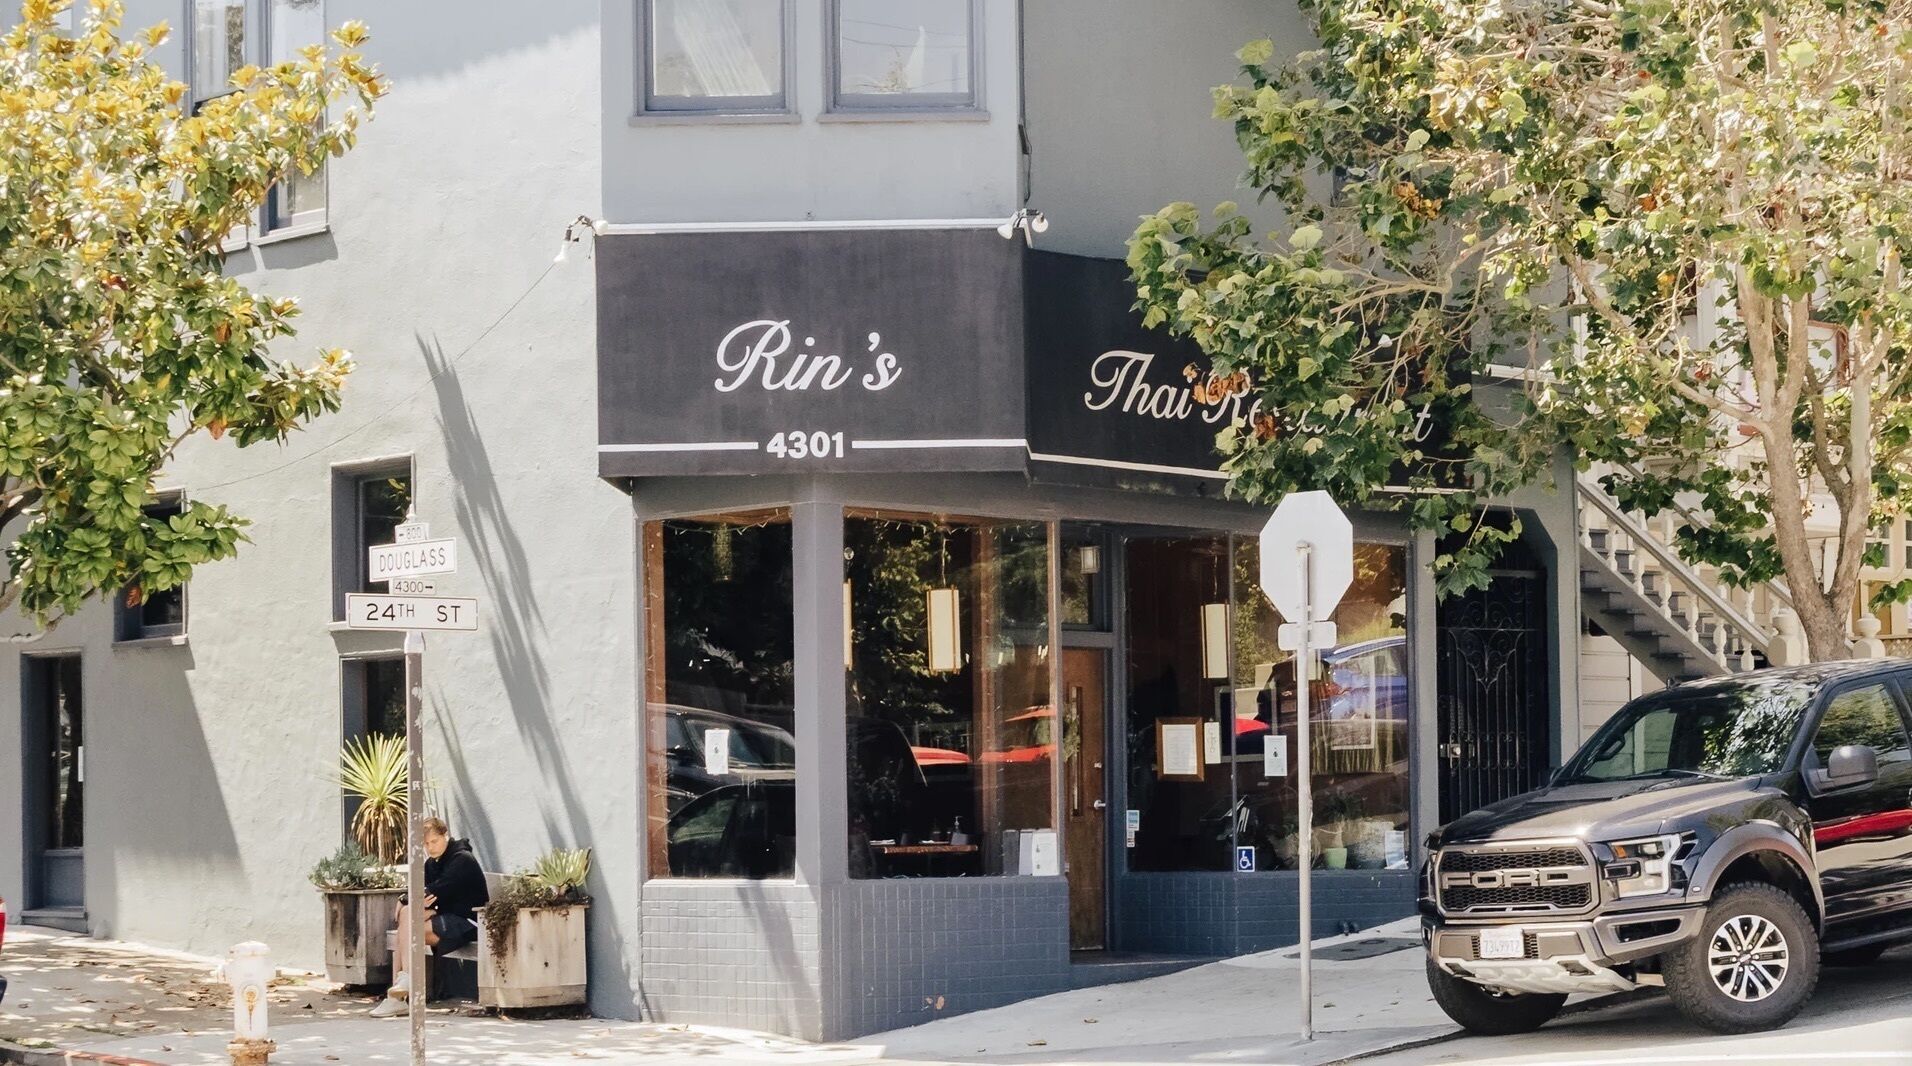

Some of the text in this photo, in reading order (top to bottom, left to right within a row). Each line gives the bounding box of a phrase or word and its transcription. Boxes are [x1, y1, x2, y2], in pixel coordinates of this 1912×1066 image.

[714, 319, 902, 392] Rin's
[1084, 350, 1193, 420] Thai
[766, 430, 844, 458] 4301
[379, 547, 446, 572] DOUGLASS
[366, 603, 461, 623] 24TH ST
[1441, 868, 1584, 889] FORD
